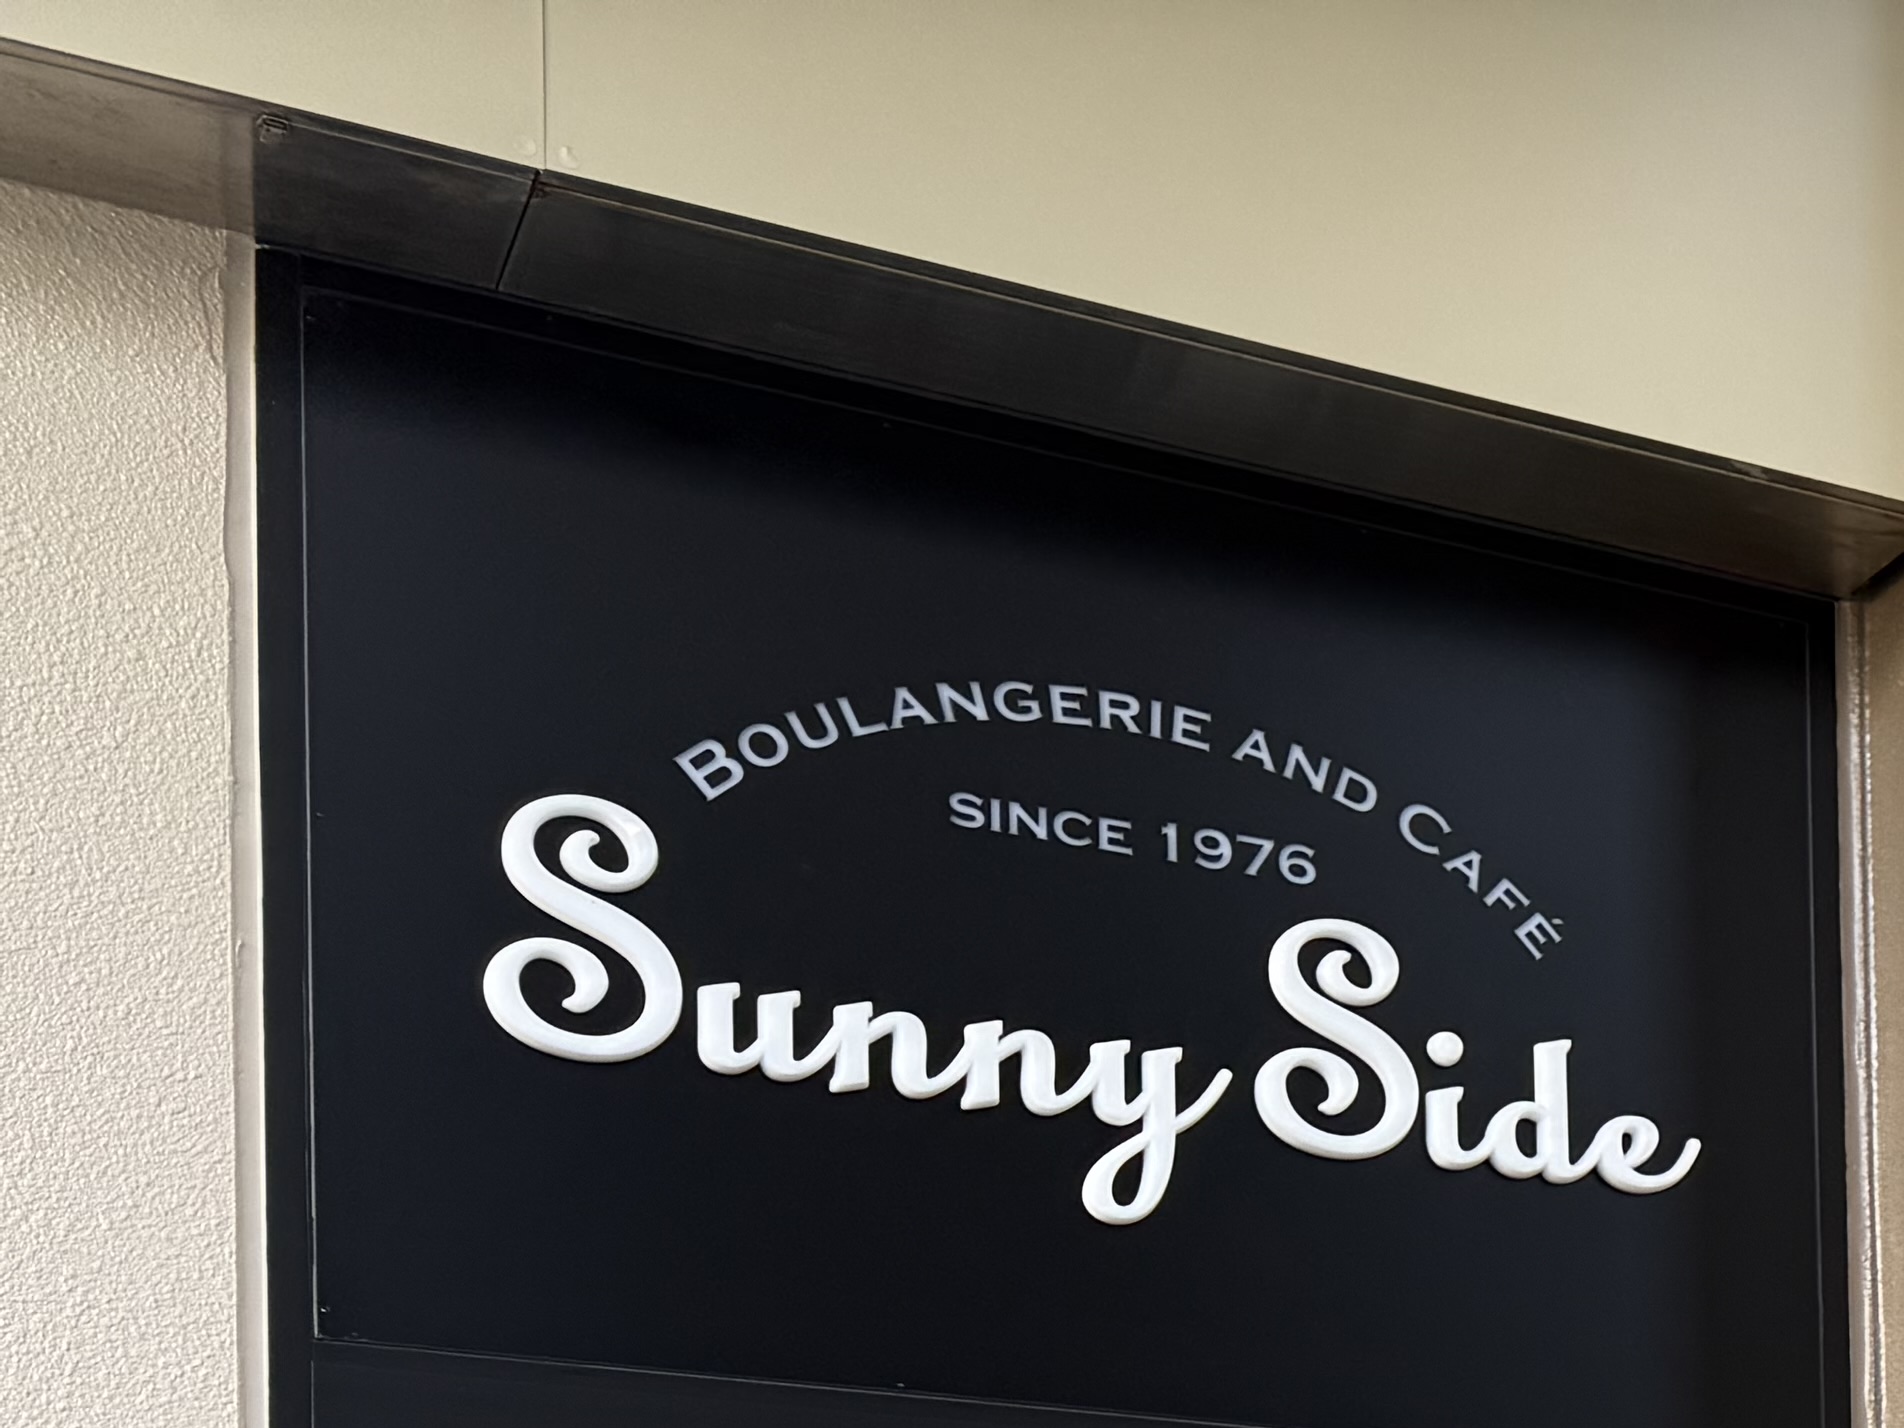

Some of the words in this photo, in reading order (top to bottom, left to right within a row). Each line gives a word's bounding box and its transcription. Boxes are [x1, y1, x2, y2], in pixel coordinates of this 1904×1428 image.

[673, 679, 1213, 802] BOULANGERIE
[1231, 726, 1380, 813] AND
[1399, 802, 1566, 962] CAFÉ
[947, 791, 1135, 857] SINCE
[1157, 821, 1319, 886] 1976
[482, 793, 1233, 1225] Sunny
[1253, 917, 1702, 1195] Side
